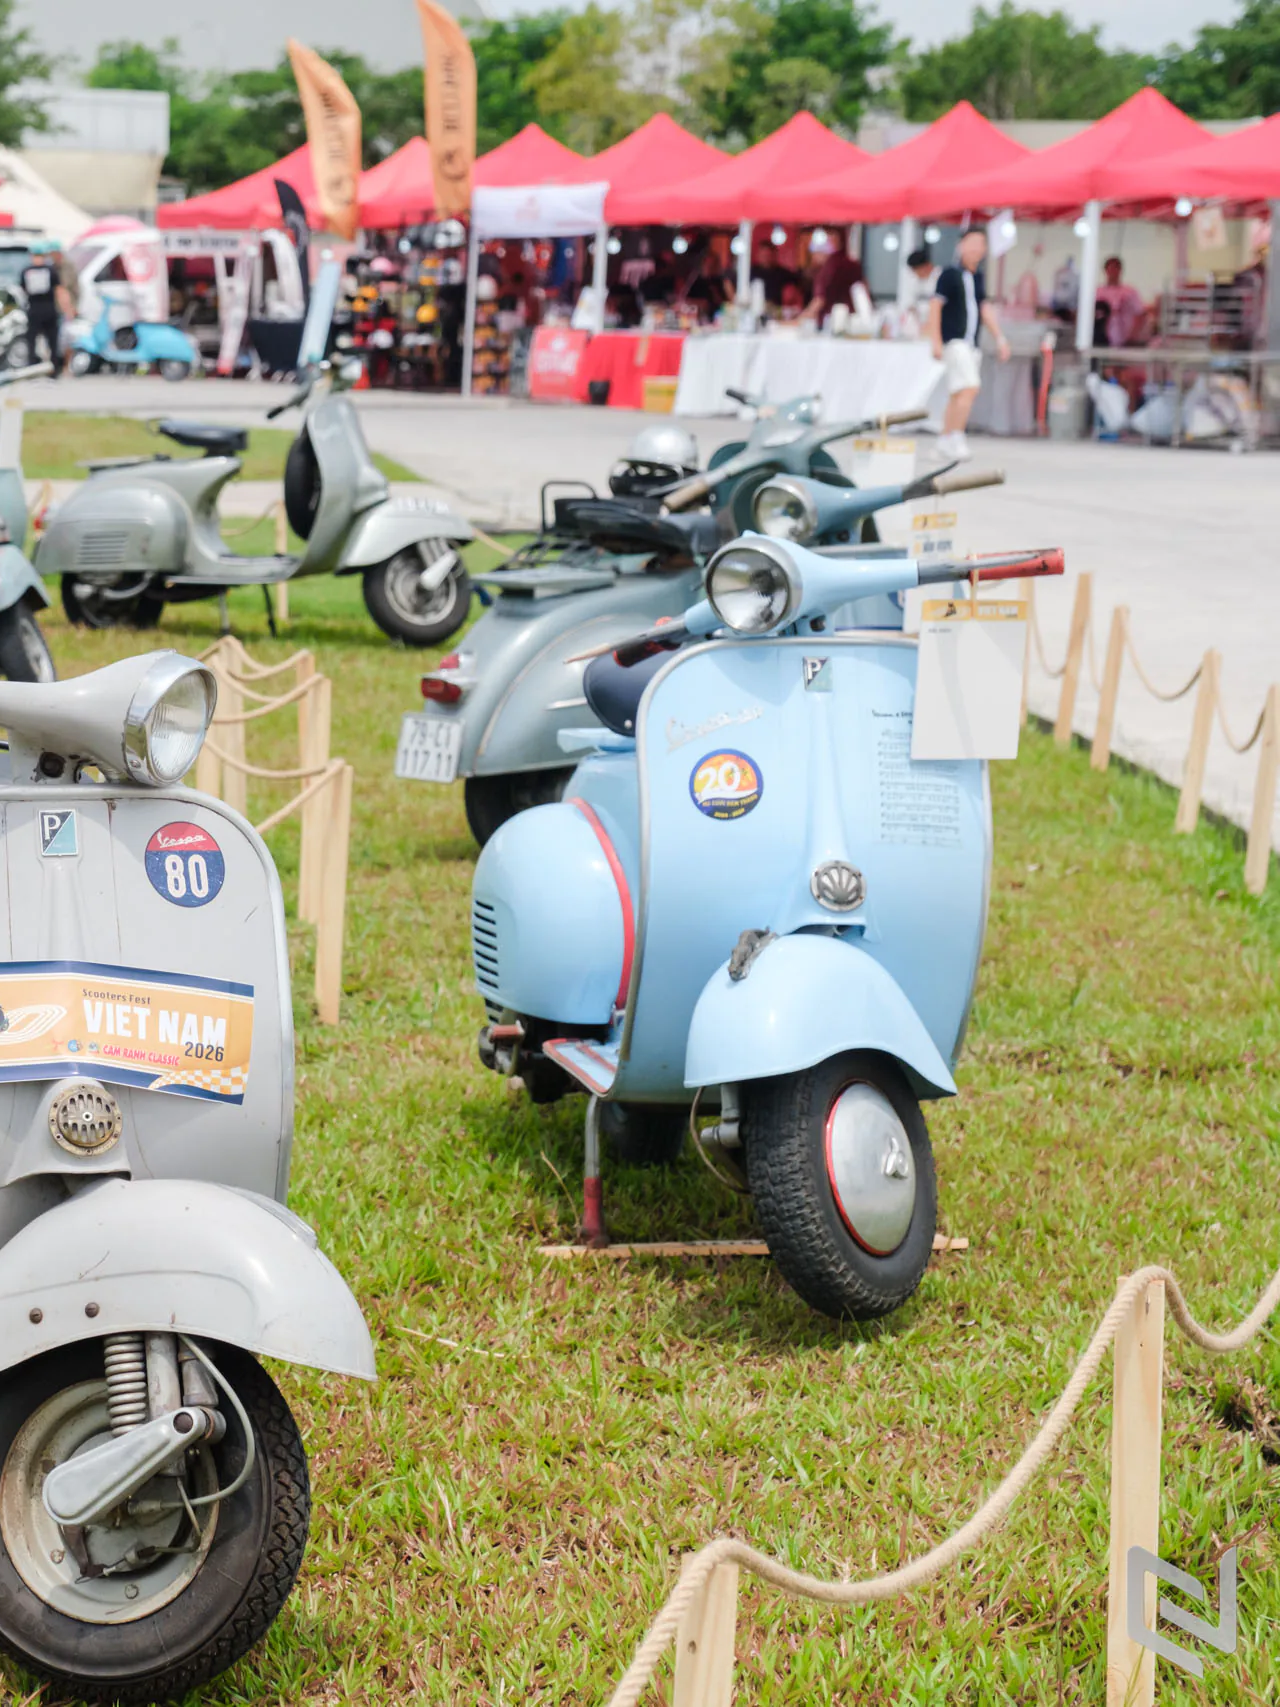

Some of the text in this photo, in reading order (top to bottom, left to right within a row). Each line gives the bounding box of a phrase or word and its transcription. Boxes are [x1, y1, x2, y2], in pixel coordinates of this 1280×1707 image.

[697, 761, 741, 795] 20
[43, 815, 61, 840] P
[156, 830, 207, 849] Vespa
[164, 854, 209, 899] 80
[82, 988, 151, 1005] Scooters Fest
[82, 999, 227, 1047] VIET NAM
[102, 1044, 181, 1066] CAM RANH CLASSIC
[184, 1041, 225, 1062] 2026
